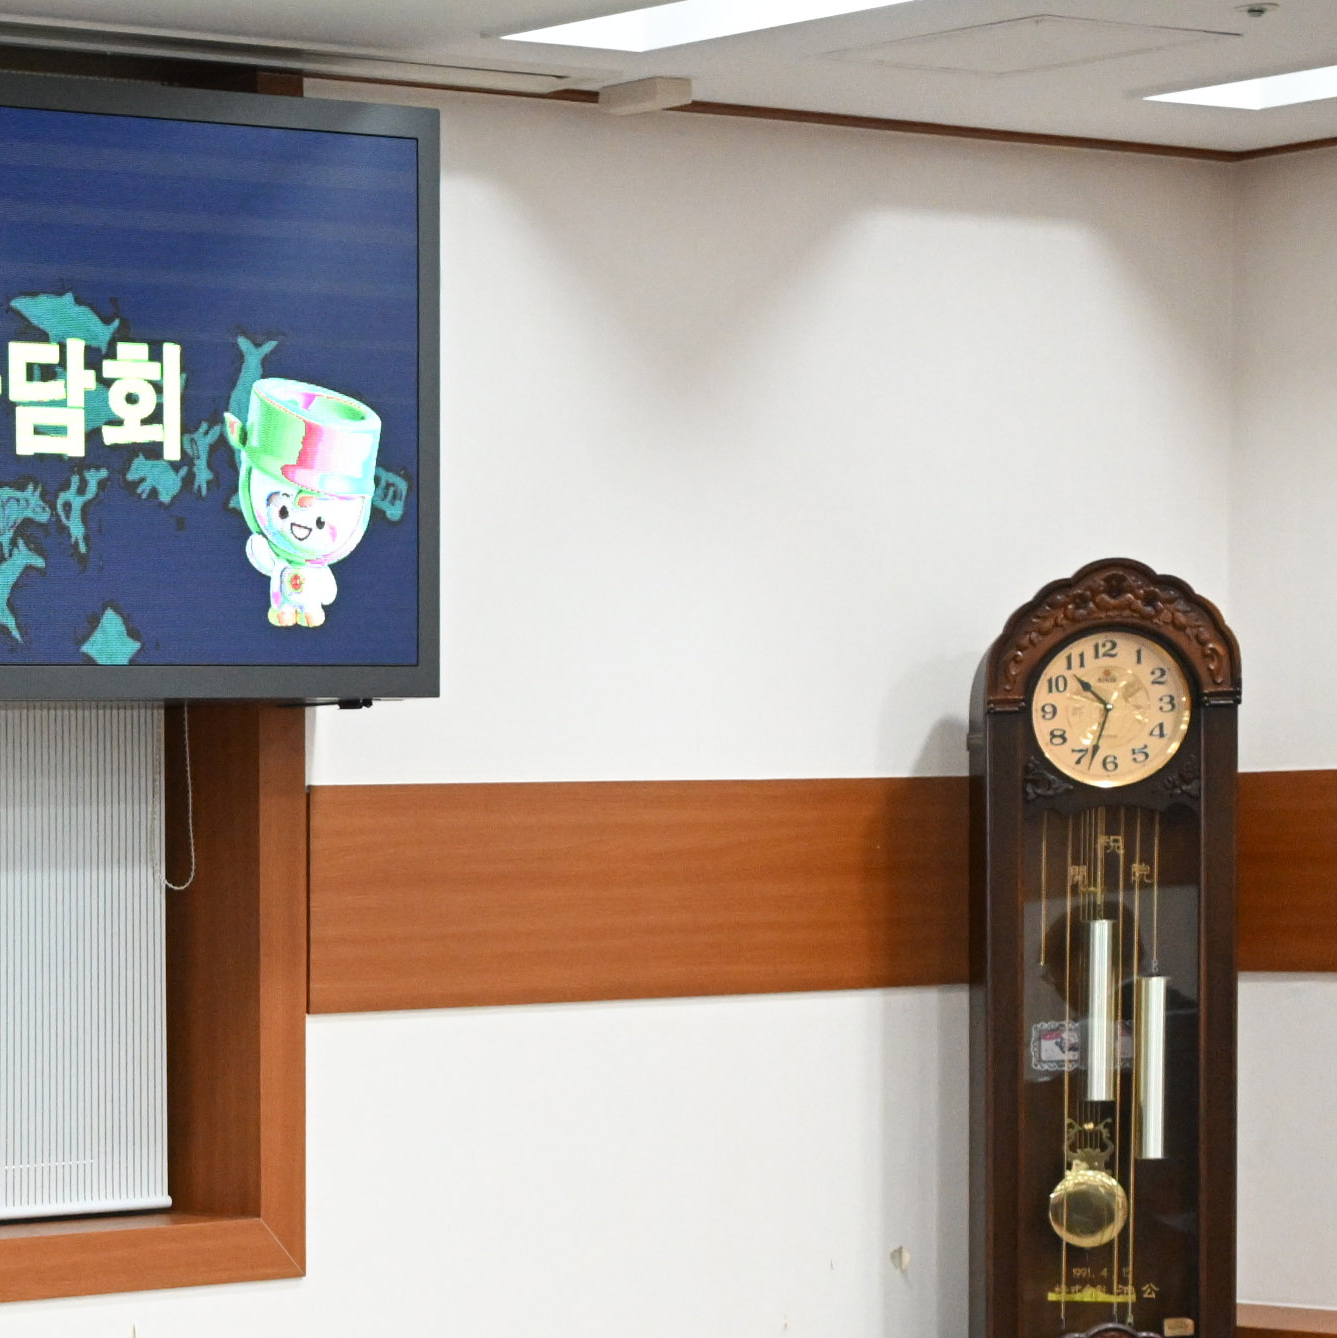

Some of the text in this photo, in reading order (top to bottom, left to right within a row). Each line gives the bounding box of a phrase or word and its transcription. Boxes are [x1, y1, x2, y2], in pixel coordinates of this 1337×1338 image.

[1093, 640, 1118, 659] 12
[1135, 647, 1143, 664] 1
[1065, 651, 1086, 670] 11
[1046, 674, 1068, 694] 10
[1150, 667, 1167, 685] 2
[1040, 703, 1058, 721] 9
[1158, 694, 1176, 713] 3
[1049, 728, 1068, 746] 8
[1149, 721, 1167, 739] 4
[1071, 747, 1089, 765] 7
[1131, 744, 1150, 763] 5
[1102, 754, 1119, 772] 6
